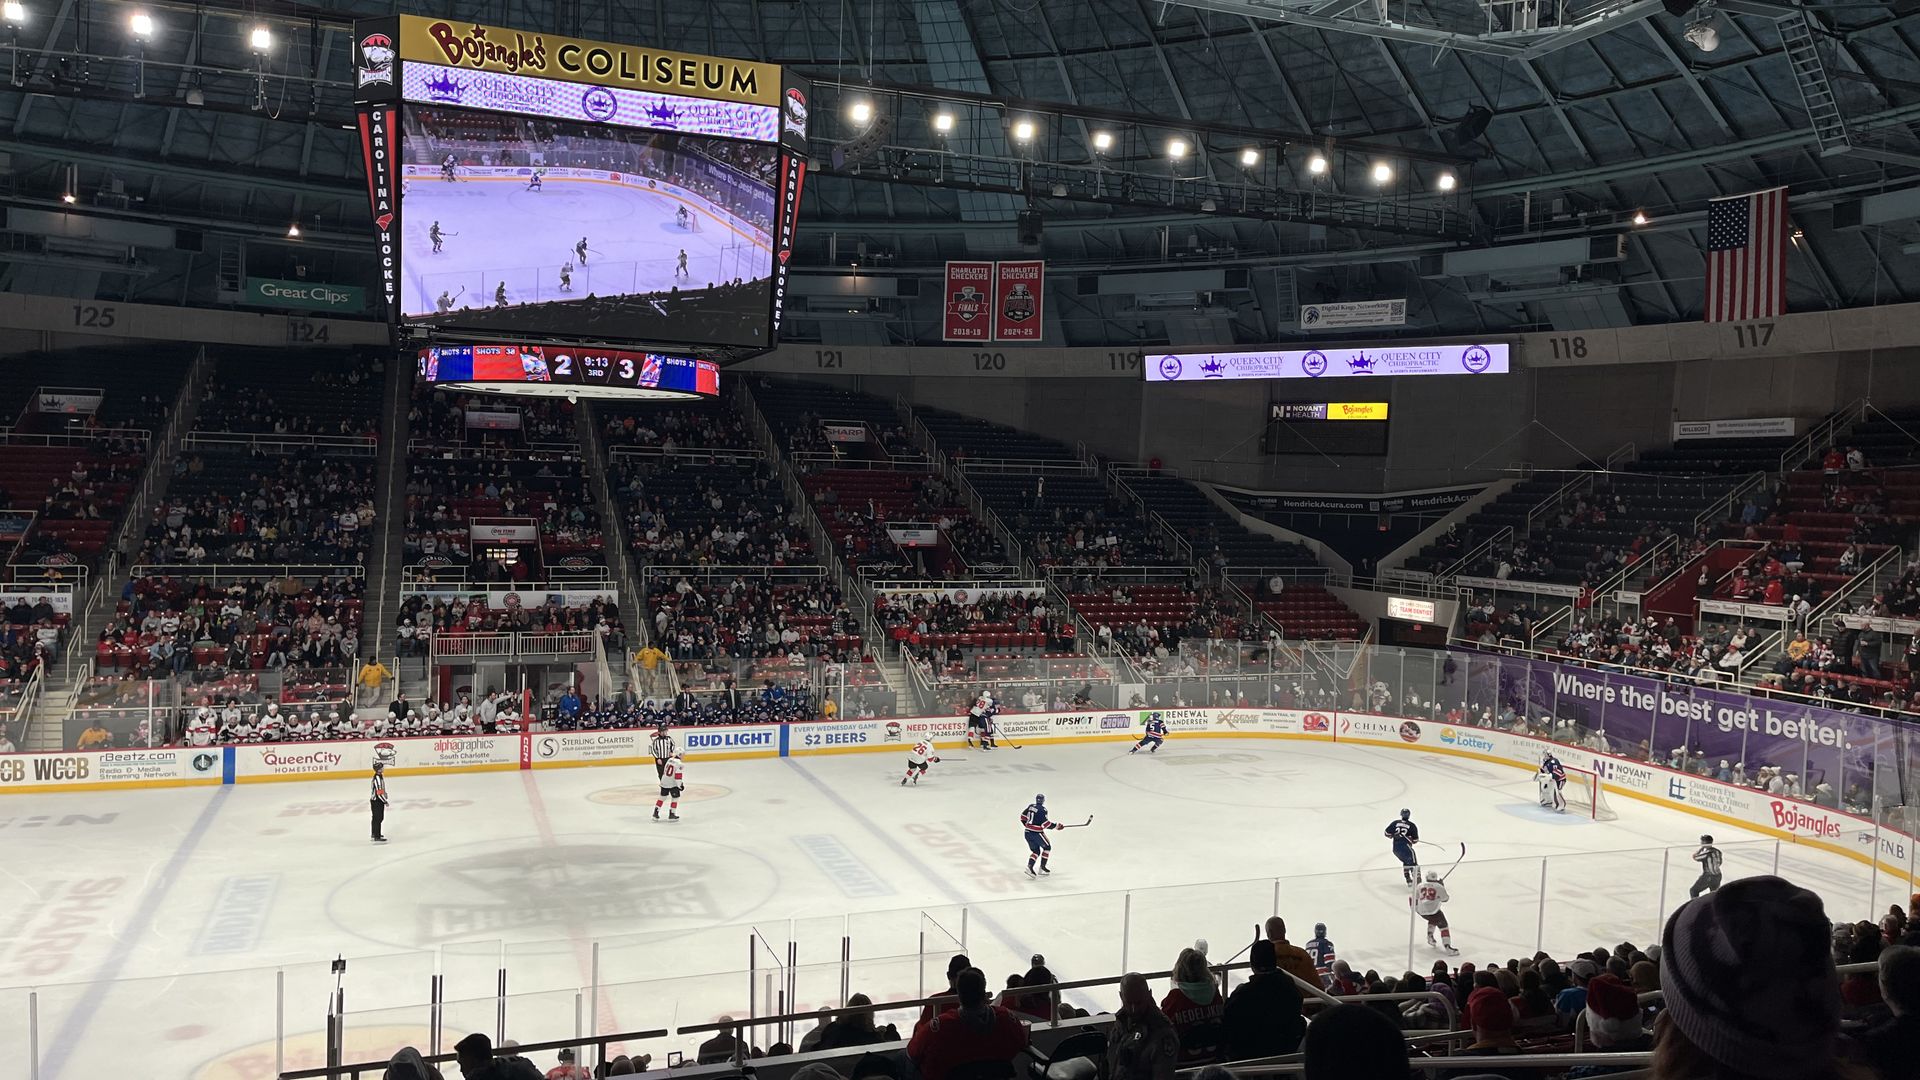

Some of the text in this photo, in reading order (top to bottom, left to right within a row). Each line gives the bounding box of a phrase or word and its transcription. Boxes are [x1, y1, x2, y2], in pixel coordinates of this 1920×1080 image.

[558, 45, 758, 94] COLISEUM
[473, 78, 555, 98] QUEEN CITY
[688, 104, 763, 123] QUEEN CITY
[372, 111, 389, 210] CAROLINA
[781, 157, 798, 247] CAROLINA
[381, 232, 395, 304] HOCKEY
[260, 283, 348, 304] Great Clips
[773, 265, 786, 331] HOCKEY
[958, 303, 979, 312] FINALS
[73, 305, 115, 328] 125
[290, 322, 330, 343] 124
[1734, 323, 1775, 348] 117
[475, 347, 500, 355] SHOTS
[1550, 337, 1588, 359] 118
[554, 354, 572, 375] 2
[584, 356, 609, 367] 9:13
[666, 357, 687, 366] SHOTS
[816, 351, 843, 368] 121
[973, 352, 1006, 370] 120
[1108, 353, 1138, 370] 119
[1229, 356, 1285, 366] QUEEN CITY
[1381, 351, 1442, 362] QUEEN CITY
[1388, 359, 1439, 367] CHIROPRACTIC
[588, 369, 604, 377] 3RD
[619, 359, 634, 379] 3
[1283, 500, 1364, 510] HendrickAcura.com
[1166, 710, 1208, 718] RENEWAL
[1553, 672, 1852, 750] Where the best get better.
[930, 722, 967, 731] TICKETS?
[1101, 718, 1129, 729] CROWN
[1354, 722, 1396, 733] CHIMA
[434, 737, 494, 753] alphagraphics
[562, 736, 634, 746] STERLING CHARTERS
[688, 732, 773, 747] BUD LIGHT
[805, 732, 867, 746] $2 BEERS
[1457, 735, 1494, 752] Lottery
[99, 752, 176, 762] rBeatz.com
[912, 743, 927, 755] 26
[264, 751, 342, 766] QueenCity
[34, 757, 89, 780] WCCB
[1616, 765, 1652, 779] NOVANT
[1615, 776, 1648, 789] HEALTH
[1770, 801, 1840, 838] Bojangles
